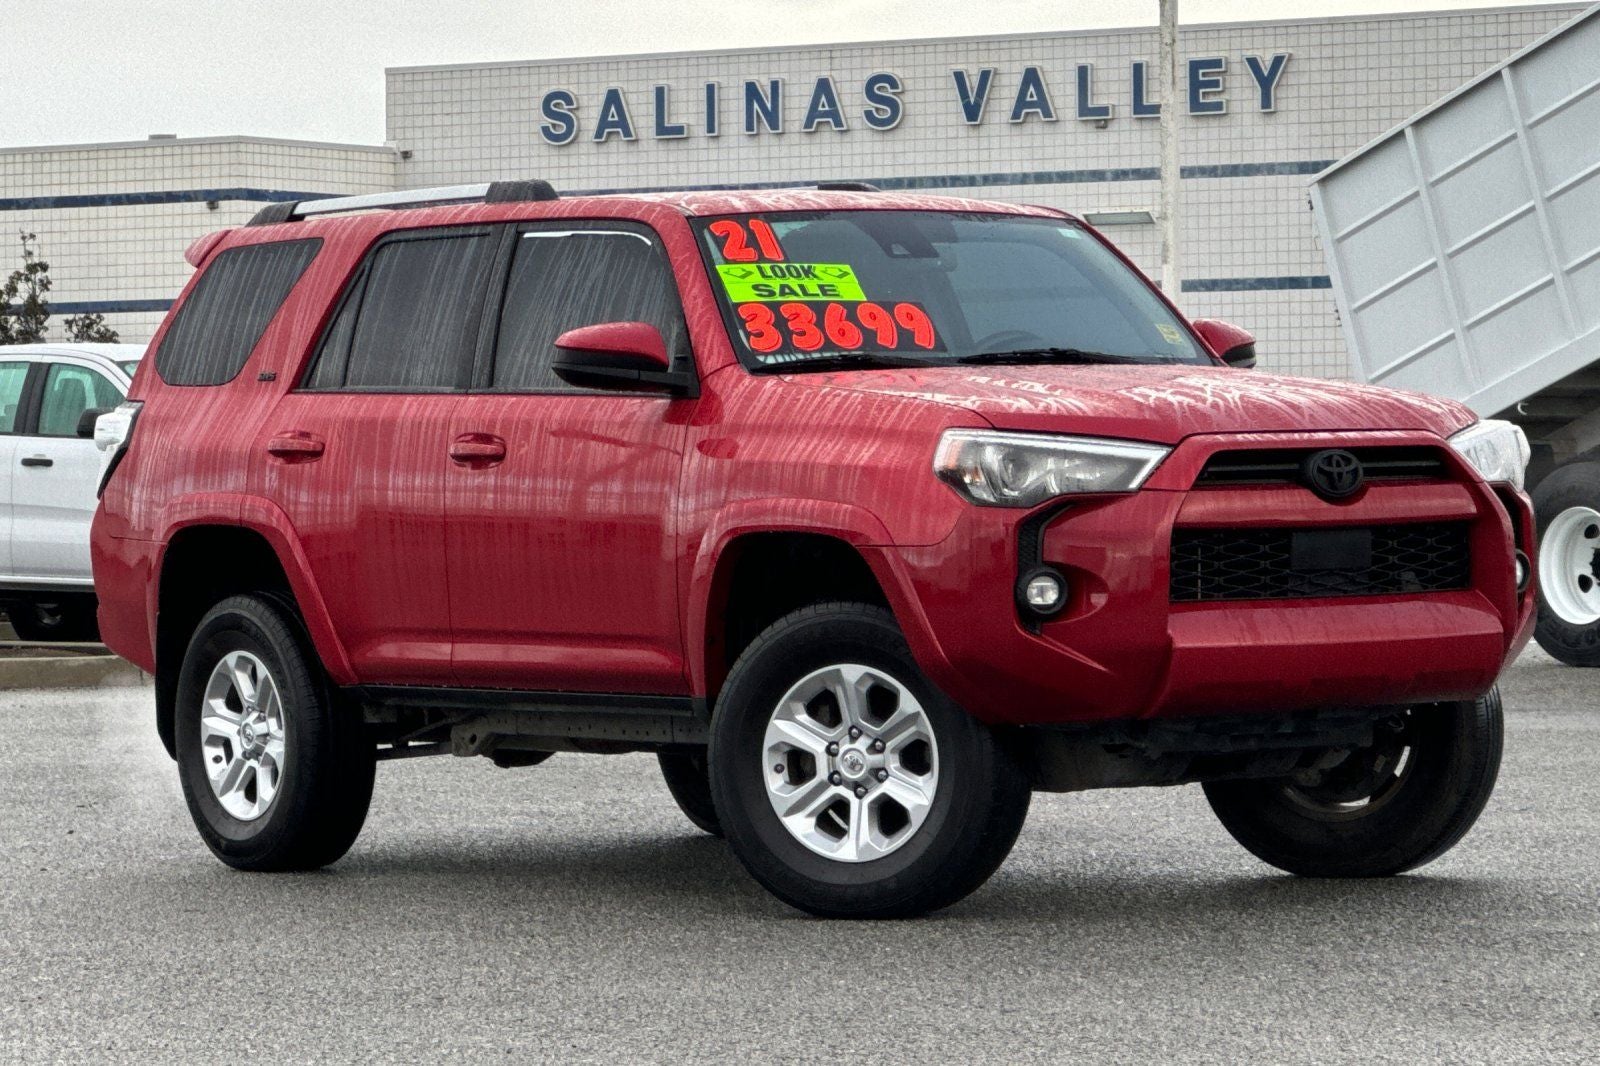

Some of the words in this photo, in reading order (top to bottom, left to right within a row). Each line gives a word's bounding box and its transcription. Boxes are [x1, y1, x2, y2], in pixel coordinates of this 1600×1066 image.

[540, 71, 904, 146] SALINAS
[951, 53, 1292, 125] VALLEY
[709, 219, 784, 262] 21
[751, 283, 842, 299] SALE
[756, 264, 823, 281] LOOK
[738, 302, 936, 352] 33699
